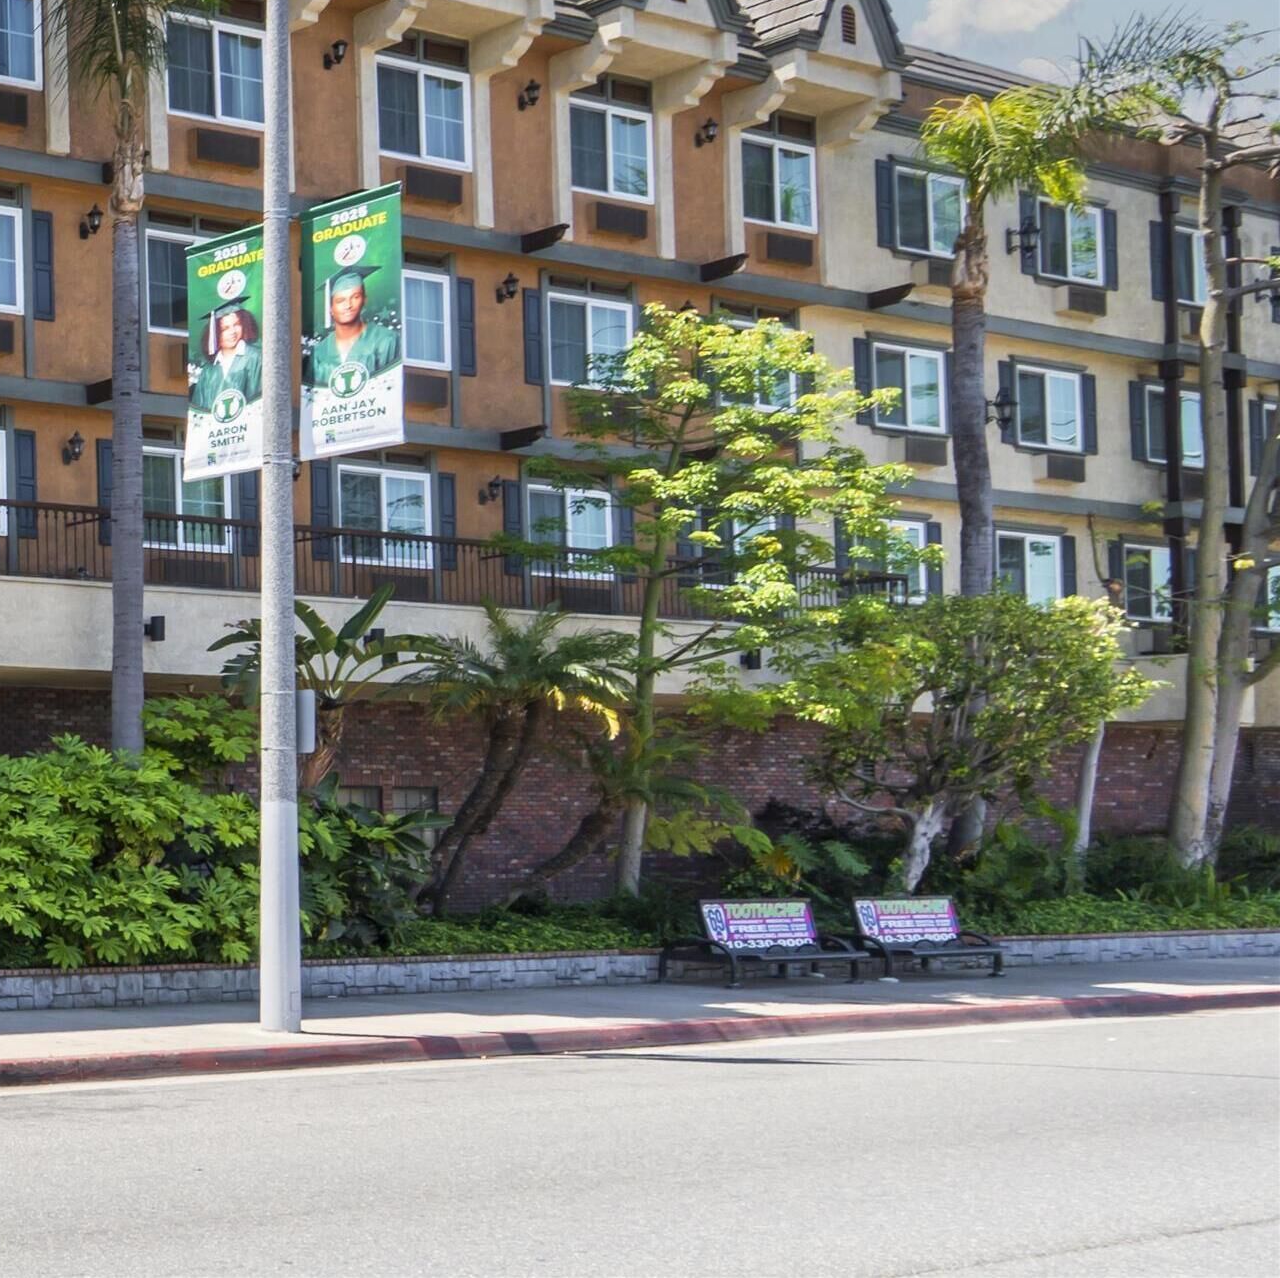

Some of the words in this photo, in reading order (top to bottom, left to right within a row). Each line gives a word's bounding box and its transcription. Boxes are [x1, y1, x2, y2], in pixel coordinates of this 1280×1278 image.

[331, 205, 368, 226] 2025
[312, 211, 387, 243] GRADUATE
[214, 242, 247, 262] 2025
[197, 248, 264, 278] GRADUATE
[312, 406, 387, 428] ROBERTSON
[208, 423, 248, 439] AARON
[210, 434, 245, 448] SMITH
[729, 924, 767, 933] FREE
[880, 919, 915, 928] FREE
